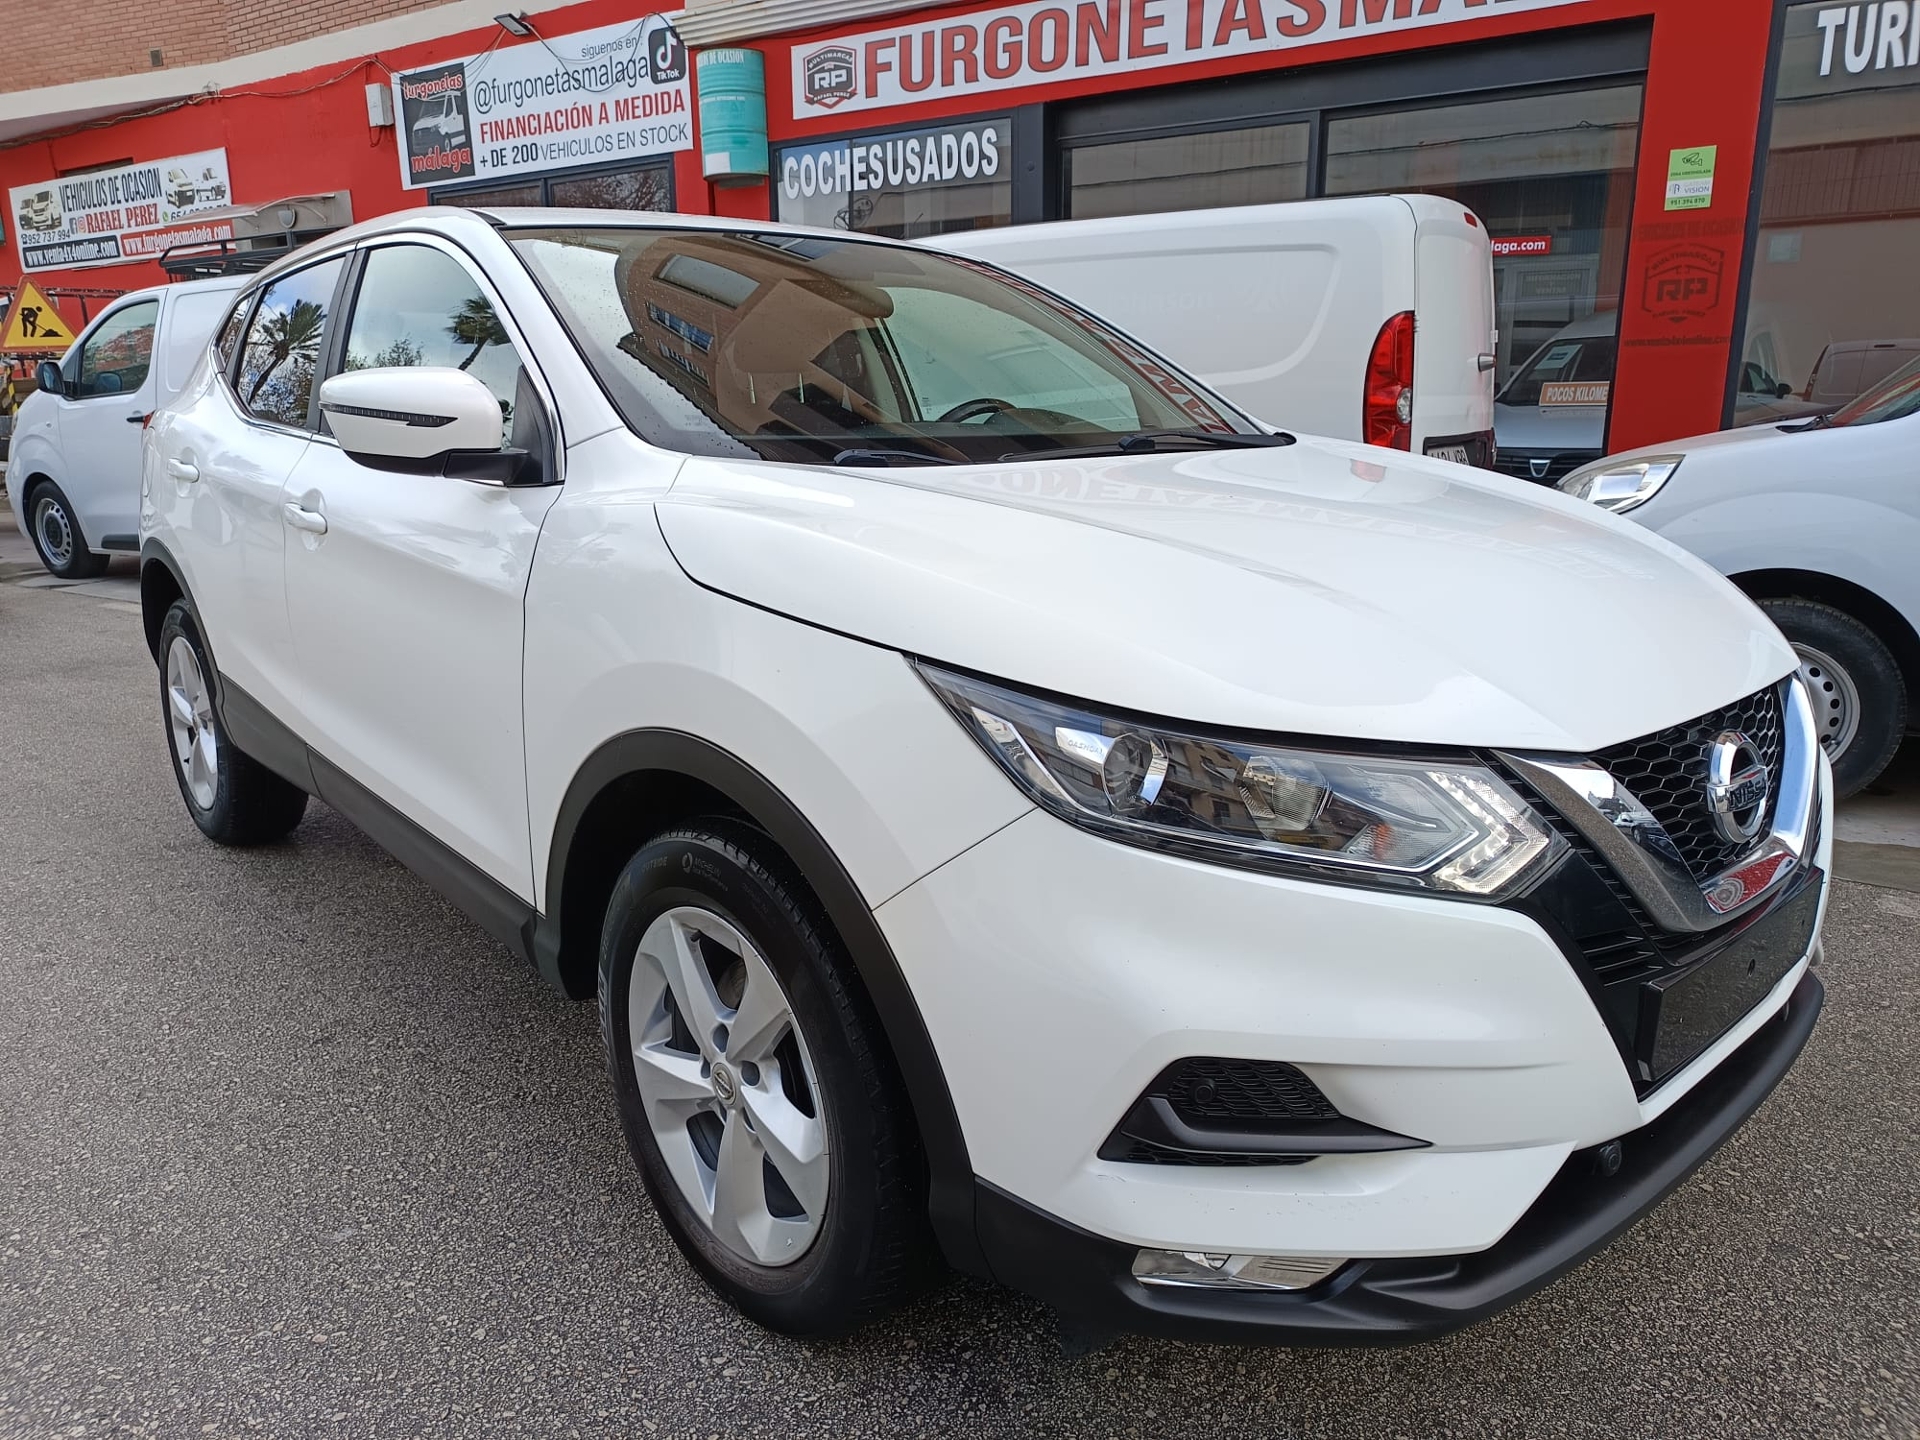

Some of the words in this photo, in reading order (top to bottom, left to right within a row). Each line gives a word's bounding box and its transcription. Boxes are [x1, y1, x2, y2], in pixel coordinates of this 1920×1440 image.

[864, 0, 1517, 99] FURGONETAS
[1818, 0, 1920, 76] TURI
[403, 72, 463, 99] furgonetas
[474, 55, 649, 114] @furgonetasmalaga
[656, 68, 680, 80] TikTok
[814, 69, 847, 89] RP
[480, 101, 593, 144] FINANCIACIÓN
[599, 102, 609, 125] A
[614, 89, 685, 122] MEDIDA
[491, 148, 507, 167] DE
[512, 142, 538, 164] 200
[540, 134, 613, 161] VEHICULOS
[617, 130, 635, 150] EN
[640, 122, 688, 146] STOCK
[411, 145, 471, 173] málaga
[58, 178, 107, 213] VEHICULOS
[108, 176, 121, 205] DE
[121, 167, 162, 203] OCASION
[1685, 185, 1709, 193] VISION
[85, 209, 124, 234] RAFAEL
[125, 203, 160, 228] PEREZ
[27, 233, 41, 245] 952
[43, 231, 56, 243] 737
[57, 228, 70, 240] 994
[1657, 277, 1708, 302] RP
[1546, 386, 1574, 401] POCOS
[1576, 385, 1608, 400] KILOME
